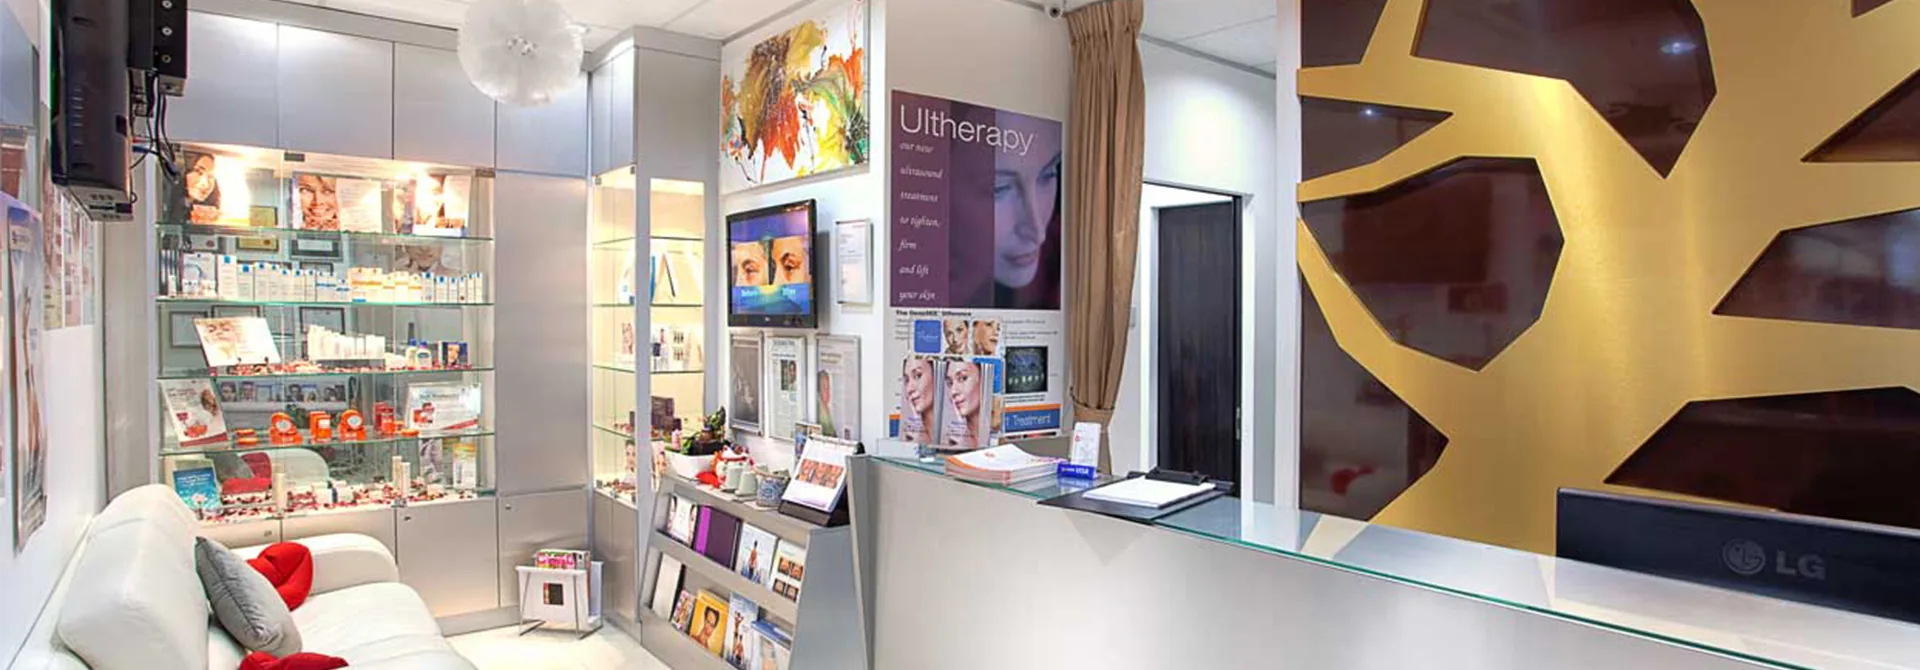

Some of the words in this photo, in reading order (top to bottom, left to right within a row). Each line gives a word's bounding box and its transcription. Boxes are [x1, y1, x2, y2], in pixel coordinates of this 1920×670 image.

[901, 104, 1034, 156] Ultherapy
[900, 142, 915, 151] our
[916, 144, 935, 153] new
[900, 164, 944, 179] ultrasound
[900, 191, 939, 202] treatment
[900, 216, 909, 224] to
[897, 238, 917, 252] firm
[899, 264, 916, 274] and
[916, 264, 929, 278] lift
[899, 291, 918, 302] your
[1776, 550, 1826, 580] LG
